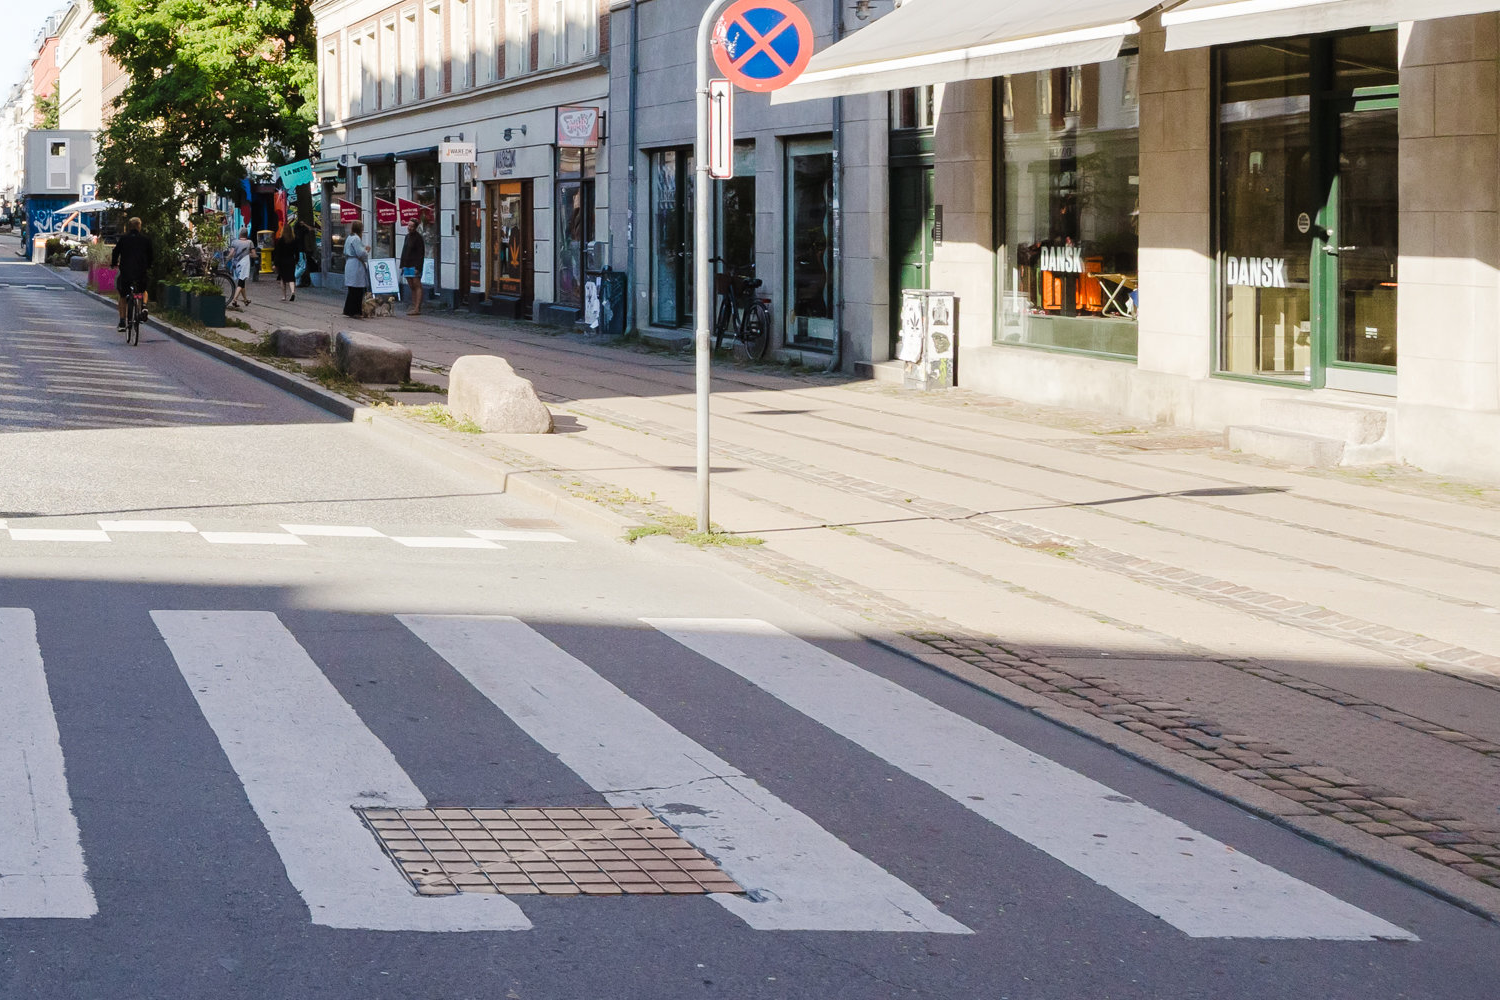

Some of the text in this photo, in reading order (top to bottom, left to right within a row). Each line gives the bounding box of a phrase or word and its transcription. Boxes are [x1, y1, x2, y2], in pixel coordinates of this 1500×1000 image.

[284, 169, 292, 177] LA
[84, 184, 94, 196] P
[1041, 246, 1082, 273] DANSK
[1227, 256, 1286, 288] DANSK
